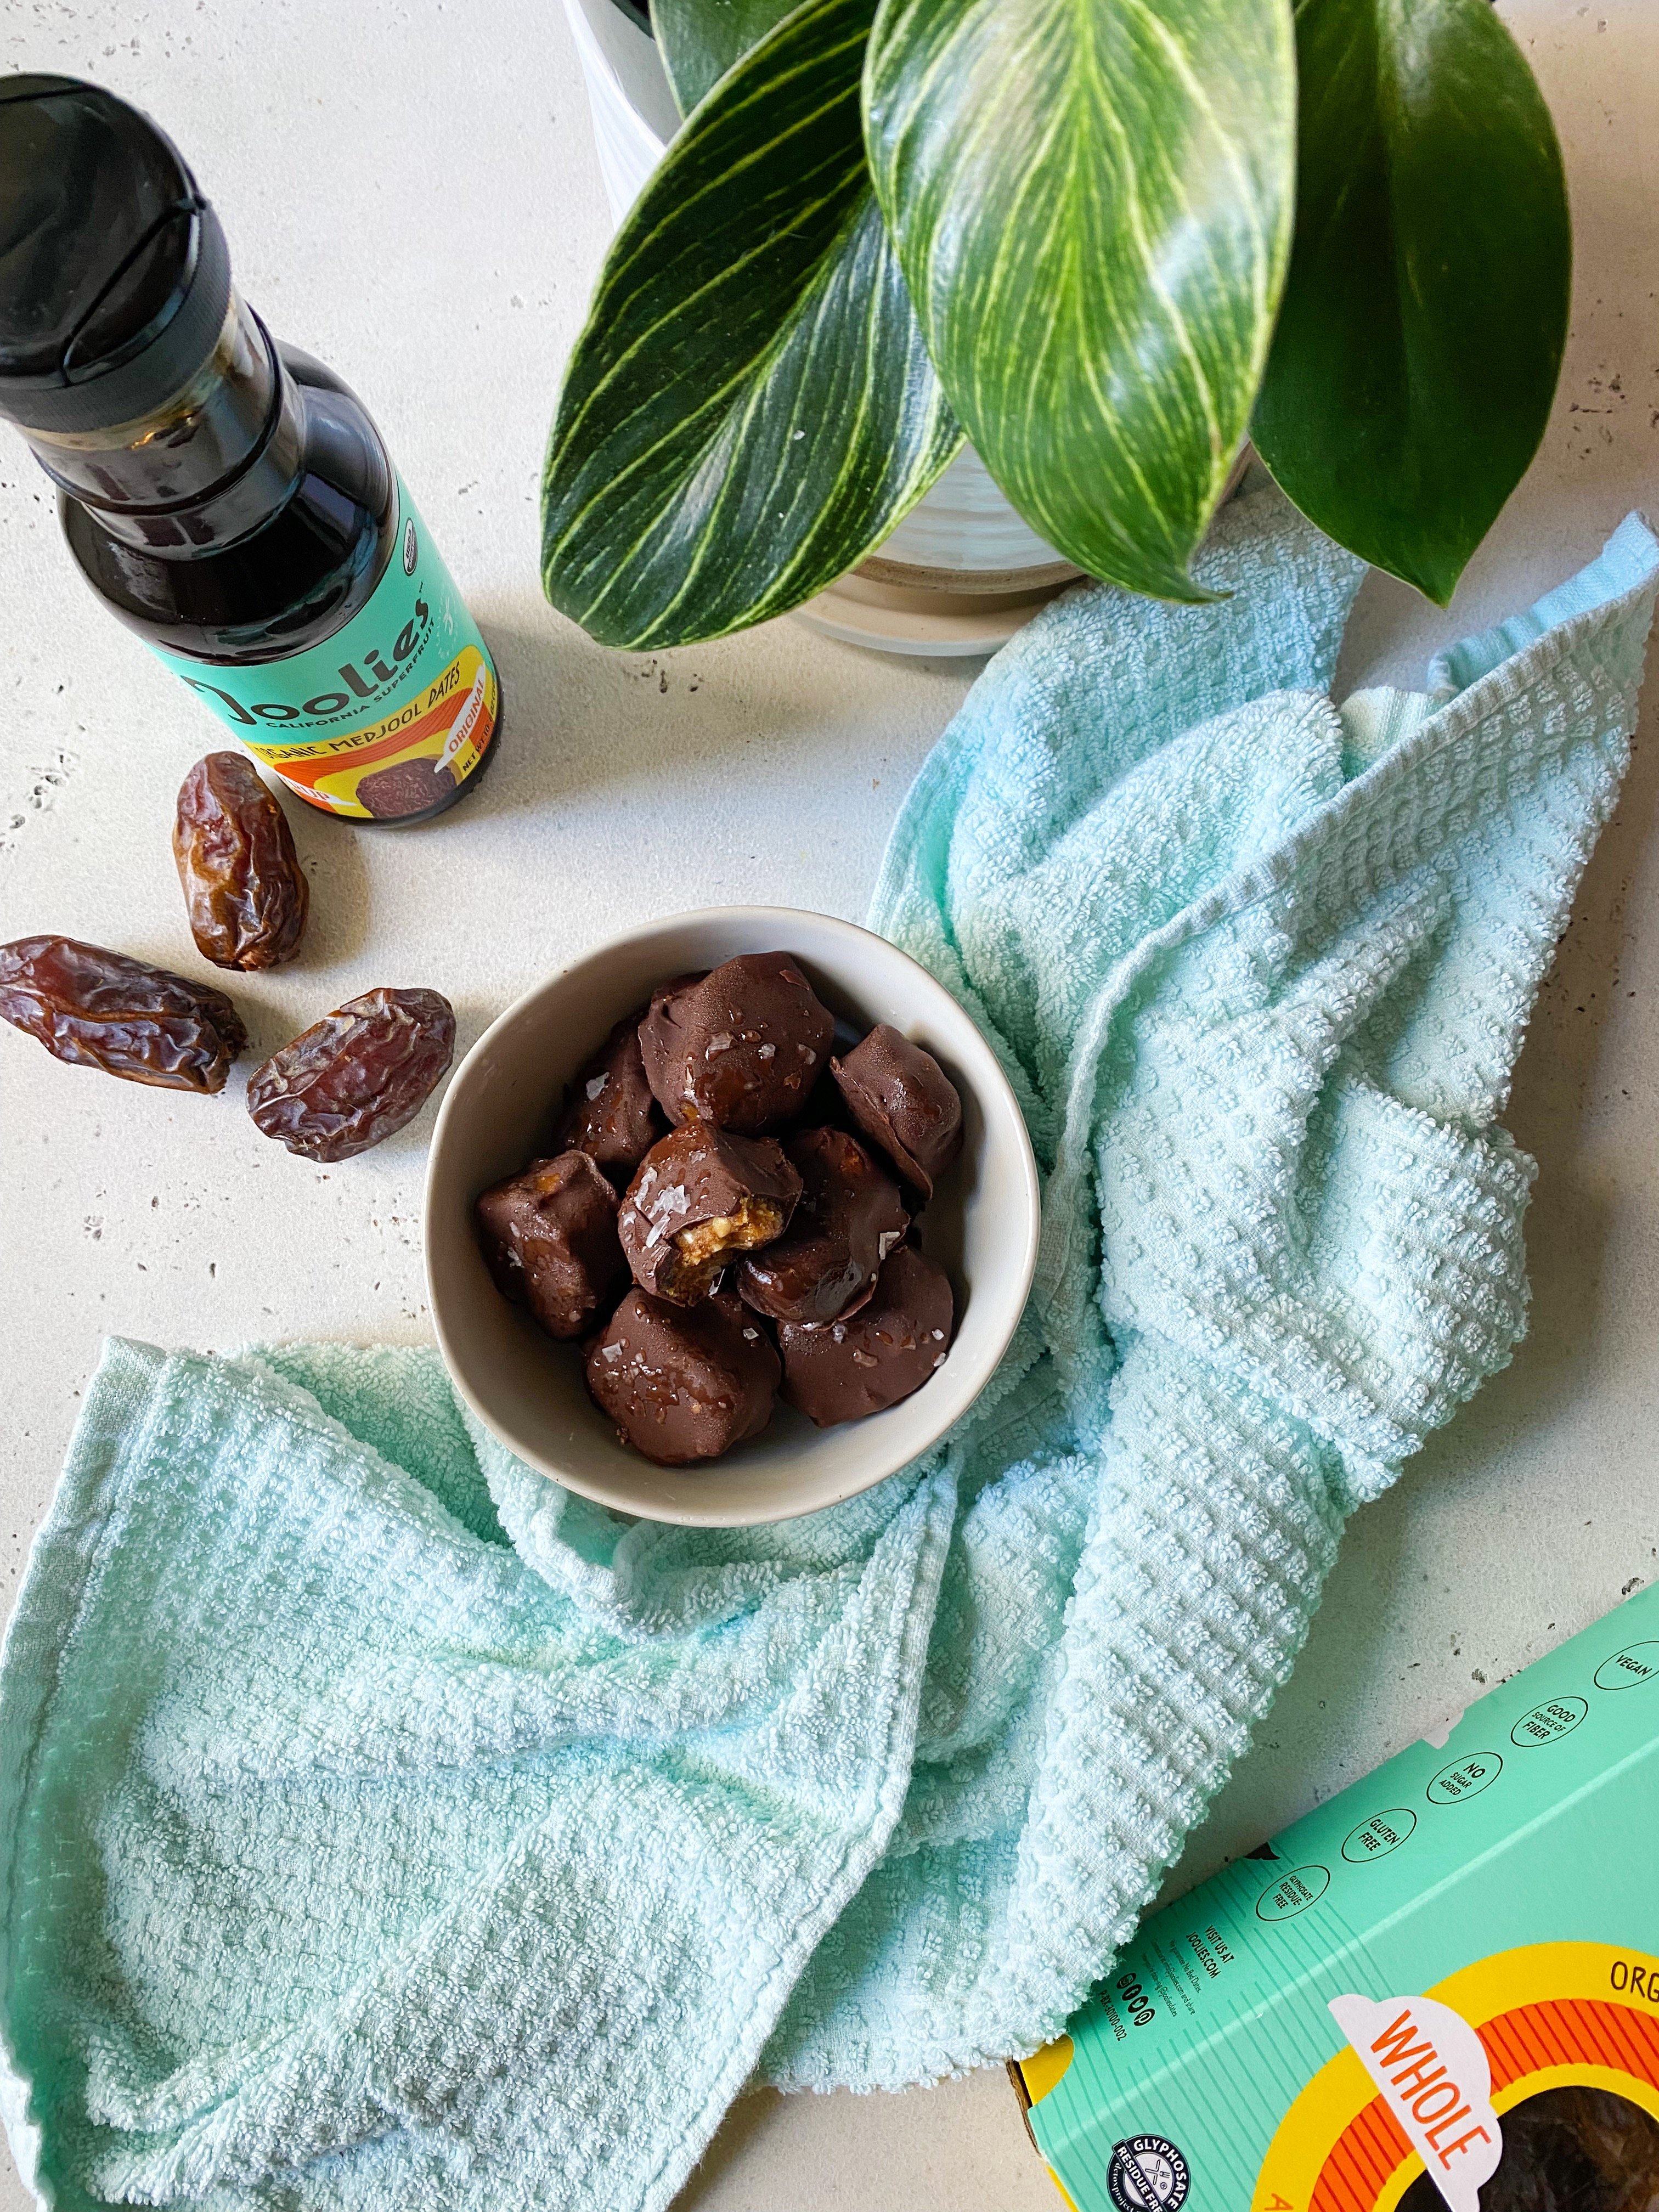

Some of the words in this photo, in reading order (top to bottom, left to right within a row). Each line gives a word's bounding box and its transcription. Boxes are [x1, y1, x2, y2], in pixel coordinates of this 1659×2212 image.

[180, 597, 429, 725] Joolies
[266, 706, 370, 728] CALIFORNIA
[374, 617, 435, 703] SUPERFRUIT
[329, 704, 422, 752] MEDJOOL
[428, 661, 460, 709] DATES
[449, 679, 484, 753] ORIGINAL
[462, 752, 476, 772] NET
[1616, 1655, 1652, 1676] VEGAN
[1532, 1712, 1558, 1728] SOURCE
[1547, 1705, 1576, 1722] GOOD
[1522, 1721, 1550, 1740] FIBER
[1450, 1771, 1472, 1788] SUGAR
[1463, 1762, 1486, 1778] NO
[1438, 1779, 1462, 1796] ADDED
[1358, 1831, 1381, 1852] FREE
[1370, 1819, 1401, 1845] GLUTEN
[1289, 1875, 1314, 1901] GLYPHOSATE
[1272, 1893, 1289, 1909] FREE
[1205, 1925, 1222, 1945] VISIT
[1186, 1932, 1221, 1979] JOOLIES.COM
[1215, 1941, 1228, 1955] US
[1182, 1962, 1190, 1972] No
[1221, 1953, 1234, 1964] AT
[1186, 1969, 1197, 1980] Bad
[1191, 1977, 1200, 1993] Dates.
[1181, 1994, 1190, 2004] and
[1186, 2002, 1195, 2015] share
[1099, 1989, 1127, 2041] P-BX-30100-002
[1371, 2009, 1492, 2171] WHOLE
[1117, 2146, 1150, 2195] RESIDUE
[1133, 2138, 1187, 2209] GLYPHOSATE
